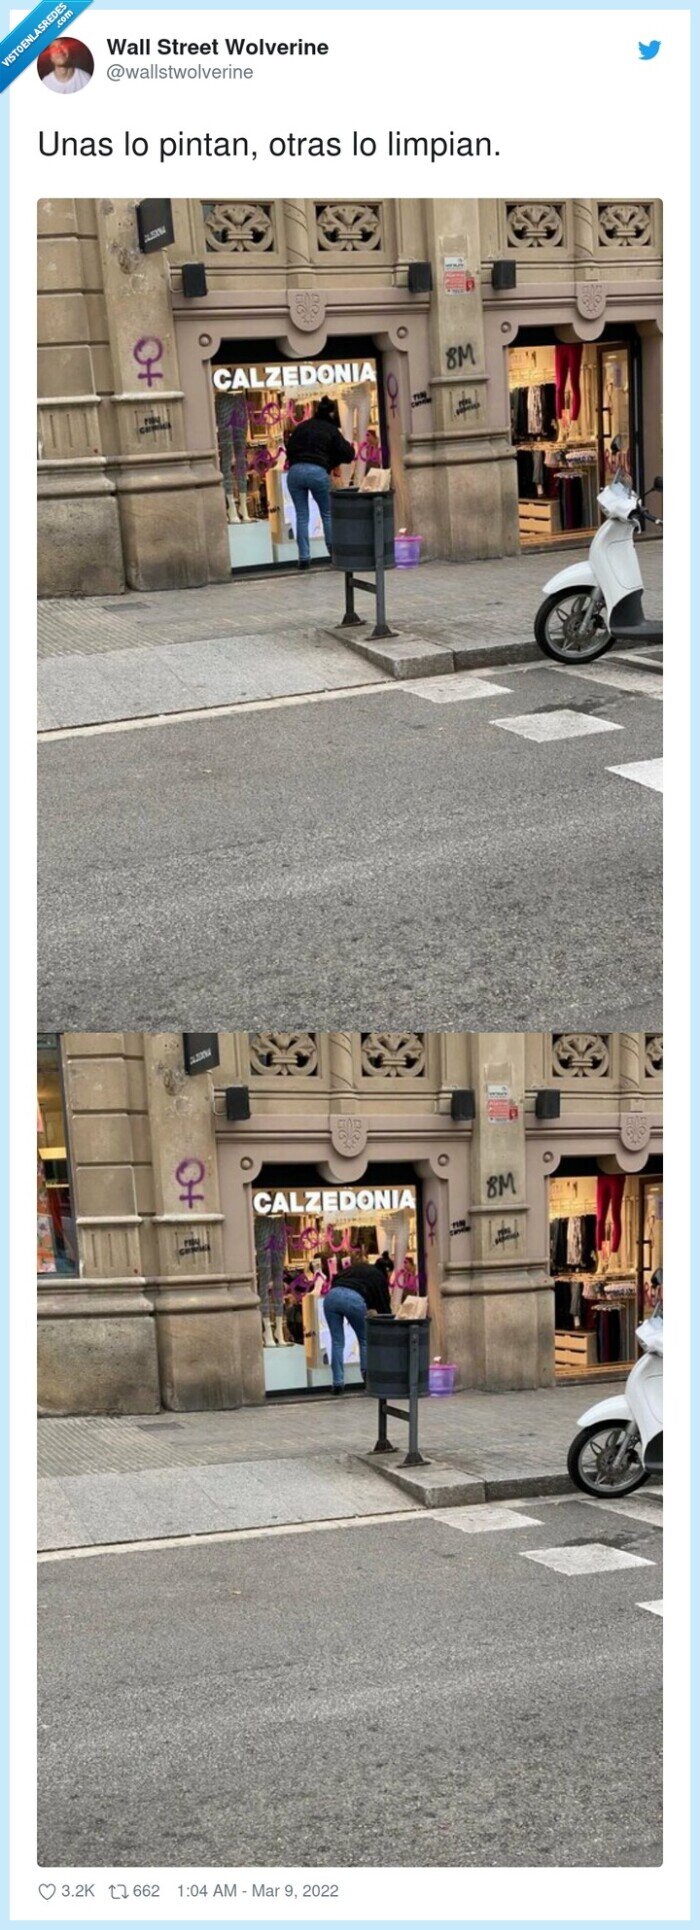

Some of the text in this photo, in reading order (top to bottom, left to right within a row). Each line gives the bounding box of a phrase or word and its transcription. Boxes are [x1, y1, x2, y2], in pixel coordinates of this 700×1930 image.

[445, 342, 476, 370] 8M
[213, 362, 377, 391] CALZEDONIA
[486, 1171, 517, 1199] 8M
[253, 1189, 416, 1215] CALZEDONIA
